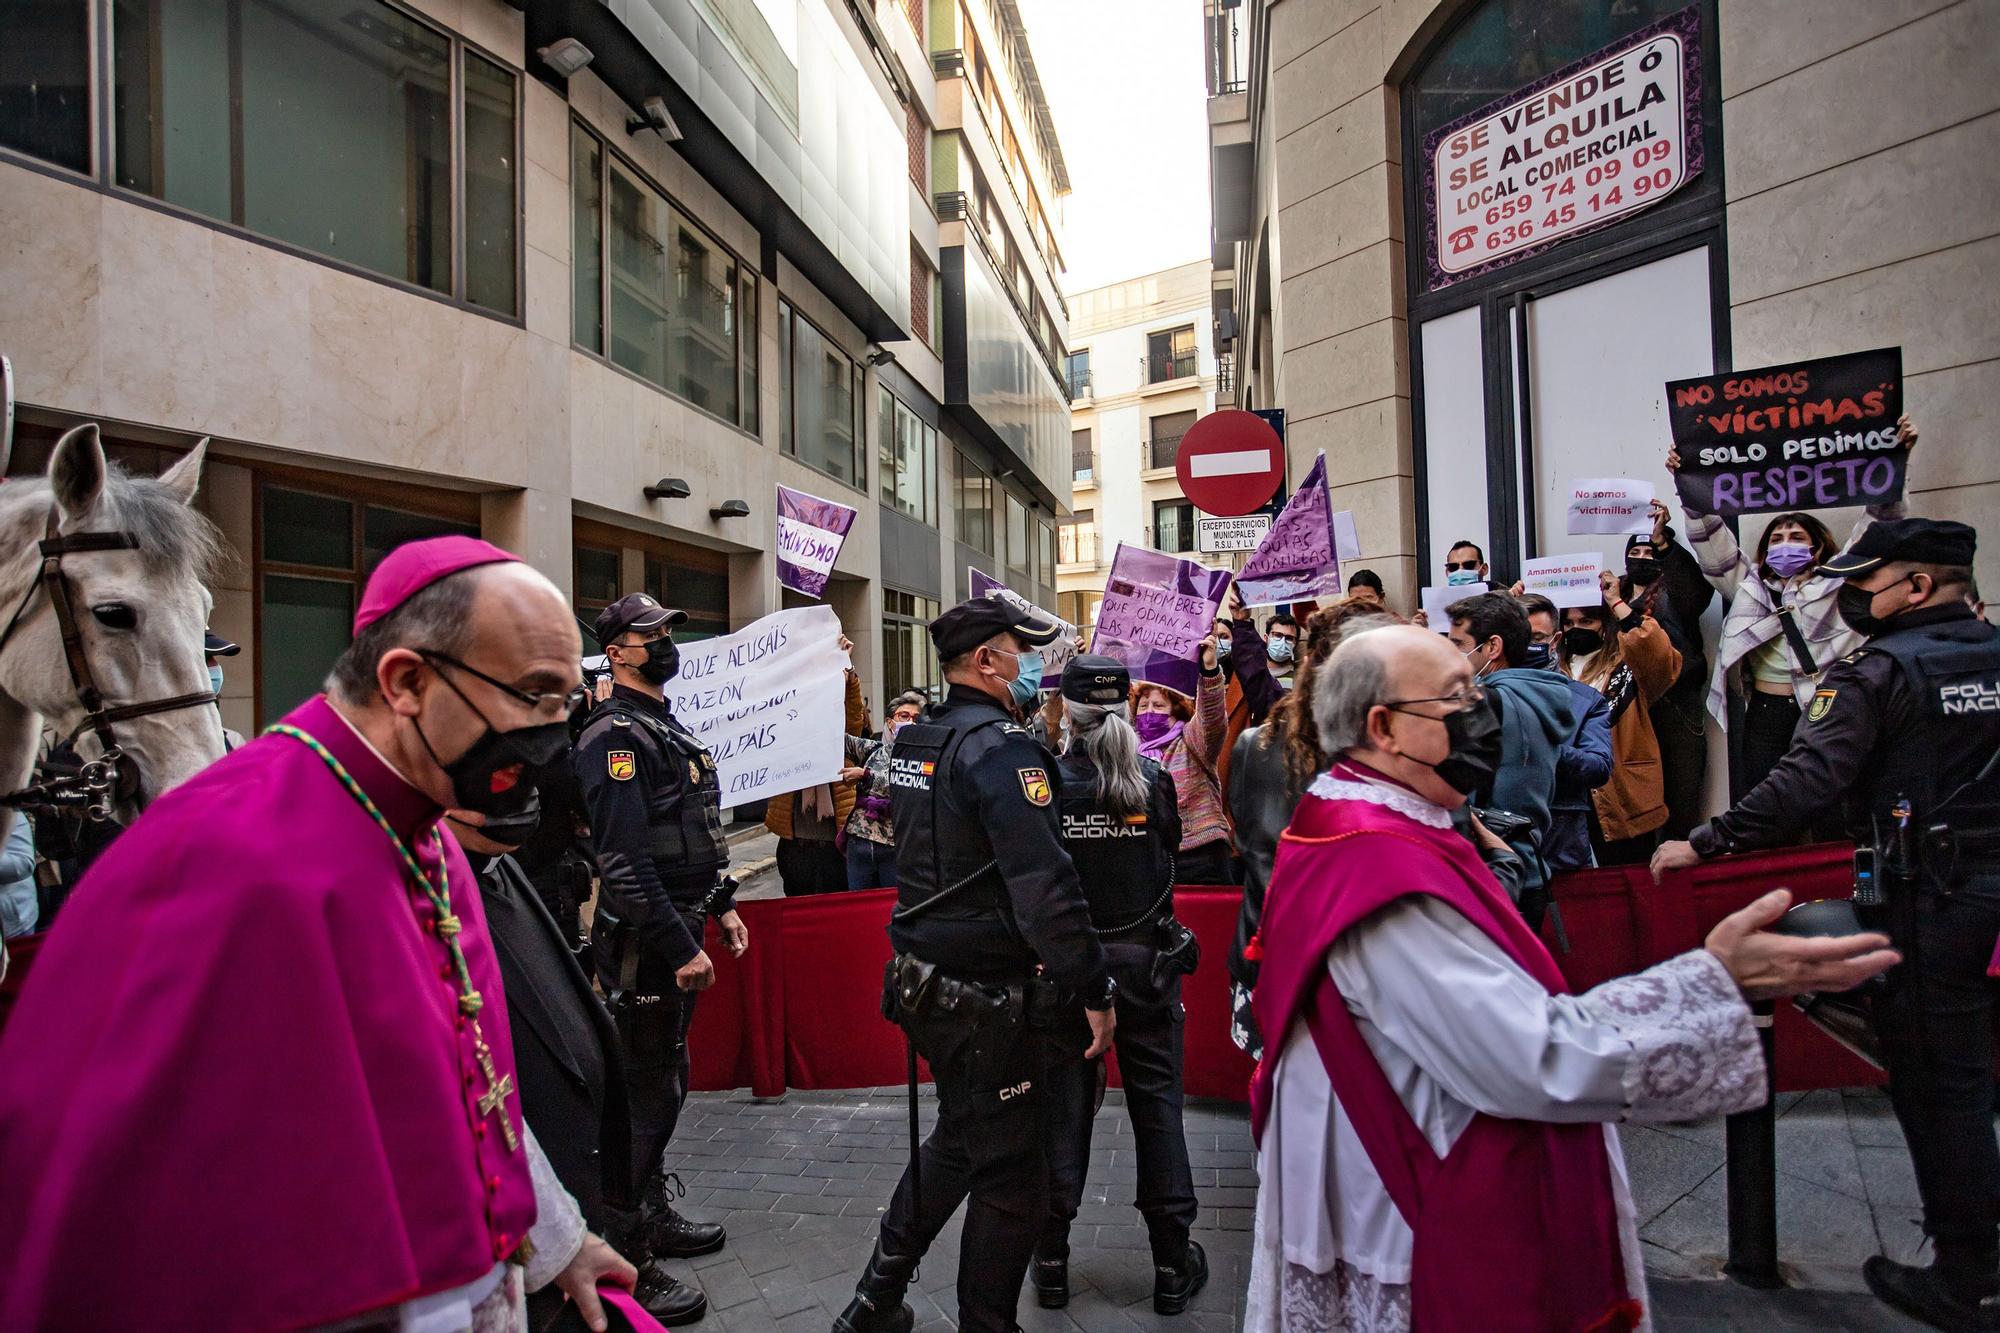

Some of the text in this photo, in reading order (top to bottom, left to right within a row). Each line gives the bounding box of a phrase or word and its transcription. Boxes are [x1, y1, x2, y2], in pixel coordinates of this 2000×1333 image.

[1450, 45, 1663, 160] SE VENDE Ó
[1449, 81, 1666, 191] SE ALQUILA
[1457, 120, 1657, 216] LOCAL COMERCIAL
[1485, 139, 1671, 226] 659 74 09 09
[1486, 167, 1672, 251] 636 45 14 90
[1675, 370, 1809, 408] NO SOMOS
[1699, 427, 1900, 466] SOLO PEDIMOS
[1575, 490, 1627, 499] No somos
[1712, 456, 1895, 510] RESPETO
[1202, 519, 1266, 530] EXCEPTO SERVICIOS
[1213, 530, 1256, 539] MUNICIPALES
[778, 521, 834, 562] EMINISMO
[1237, 540, 1241, 548] Y
[1527, 567, 1562, 577] Amamos
[1570, 563, 1596, 575] quien
[1548, 579, 1559, 587] da
[1560, 579, 1568, 587] la
[1569, 577, 1590, 589] gana
[1104, 598, 1191, 632] QUE ODIAN A
[1144, 589, 1204, 615] HOMBRES
[1100, 617, 1122, 636] LAS
[681, 652, 719, 681] QUE
[1094, 675, 1118, 684] CNP
[674, 676, 745, 714] RAZÓN
[891, 758, 924, 775] POLICIA
[730, 767, 768, 793] CRUZ
[890, 774, 930, 791] NACIONAL
[1062, 826, 1147, 839] CIONAL
[1000, 1081, 1031, 1100] CNP
